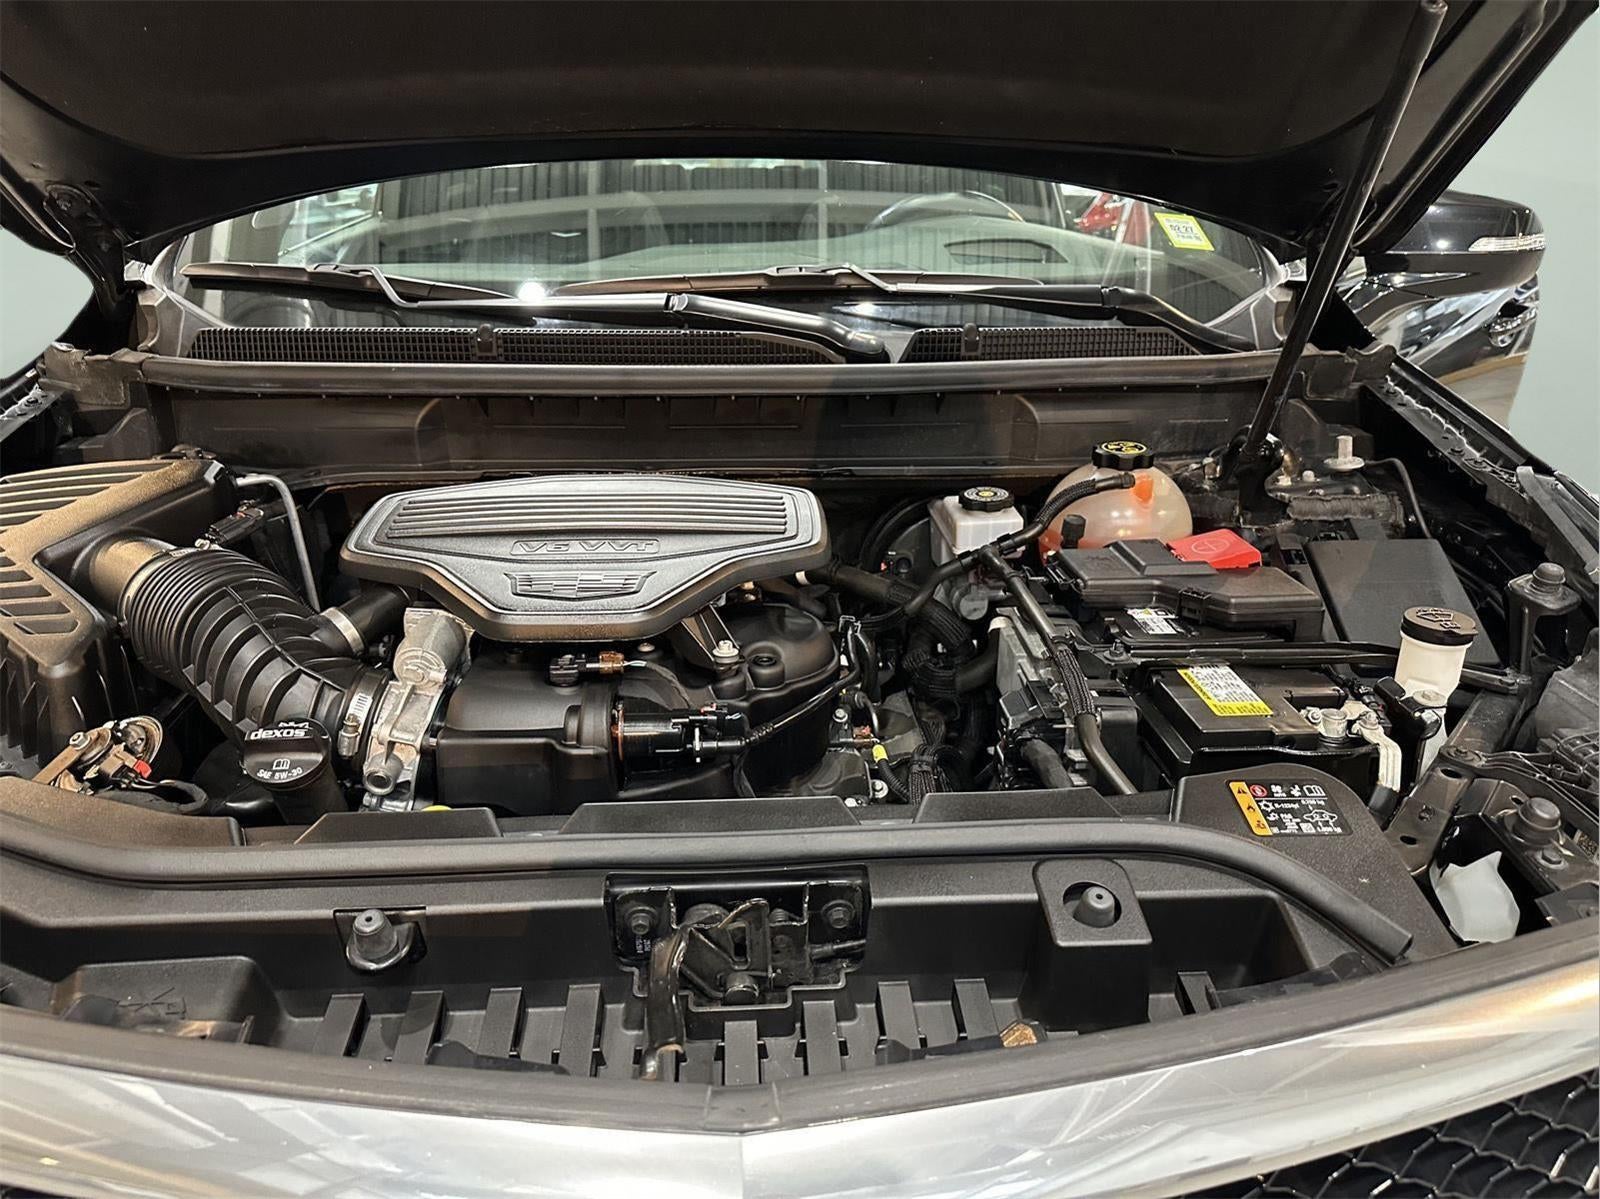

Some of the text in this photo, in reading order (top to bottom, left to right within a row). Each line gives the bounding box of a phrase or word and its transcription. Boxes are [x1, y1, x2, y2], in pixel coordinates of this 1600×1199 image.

[519, 541, 653, 552] V6 VVT
[250, 728, 309, 740] dexos
[257, 767, 303, 779] SAE 5W-30
